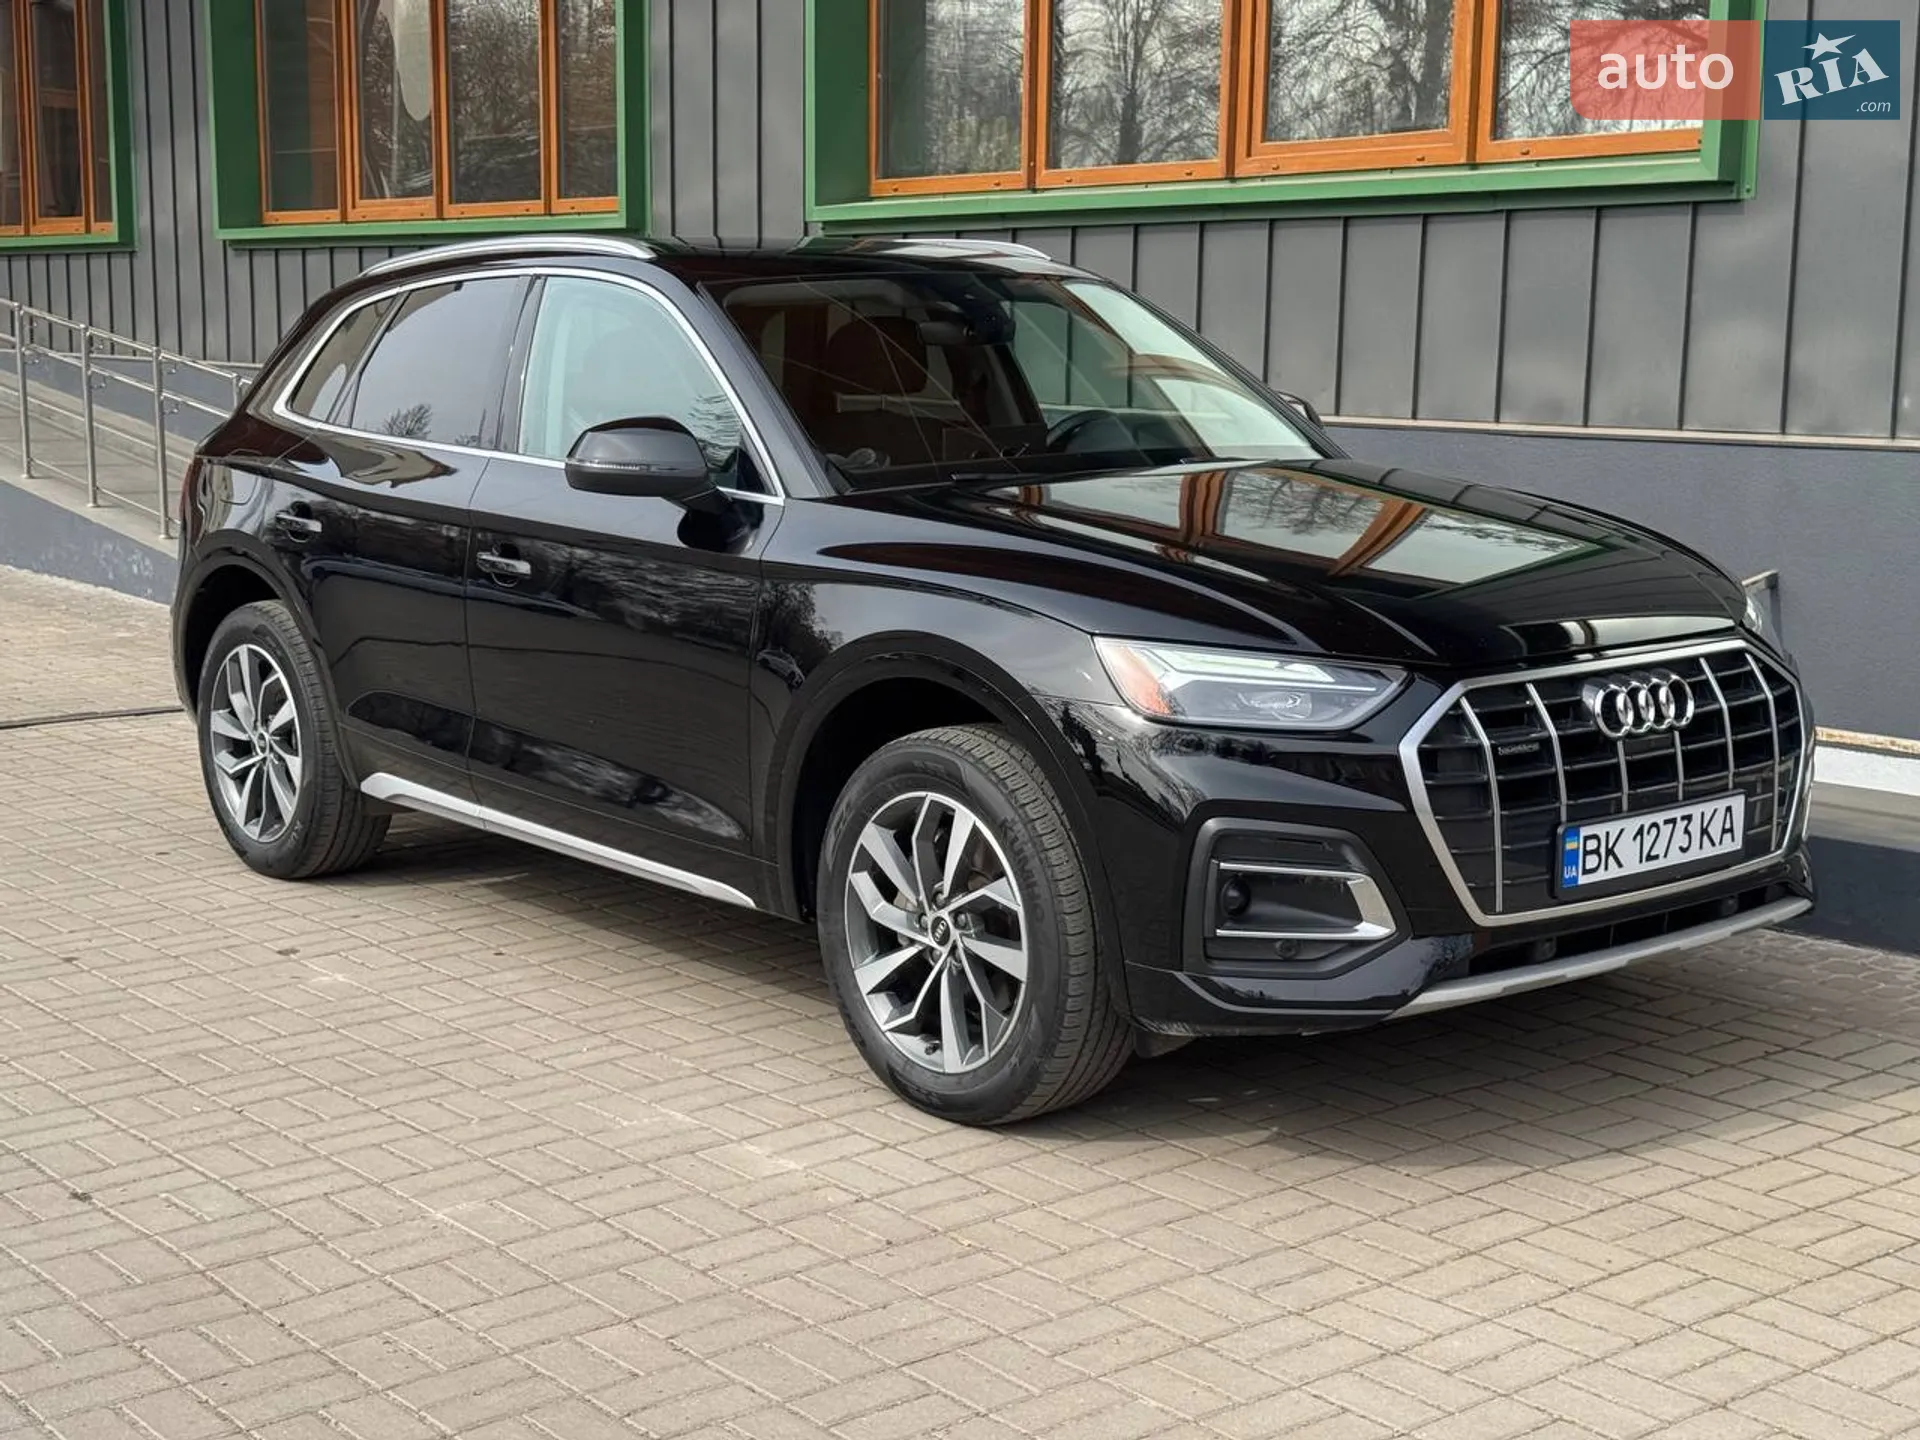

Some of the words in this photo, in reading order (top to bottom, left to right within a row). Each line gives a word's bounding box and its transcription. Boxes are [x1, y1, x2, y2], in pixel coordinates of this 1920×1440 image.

[1581, 827, 1626, 876] BK
[1632, 813, 1694, 865] 1273
[1699, 804, 1736, 850] KA
[1563, 864, 1578, 879] UA
